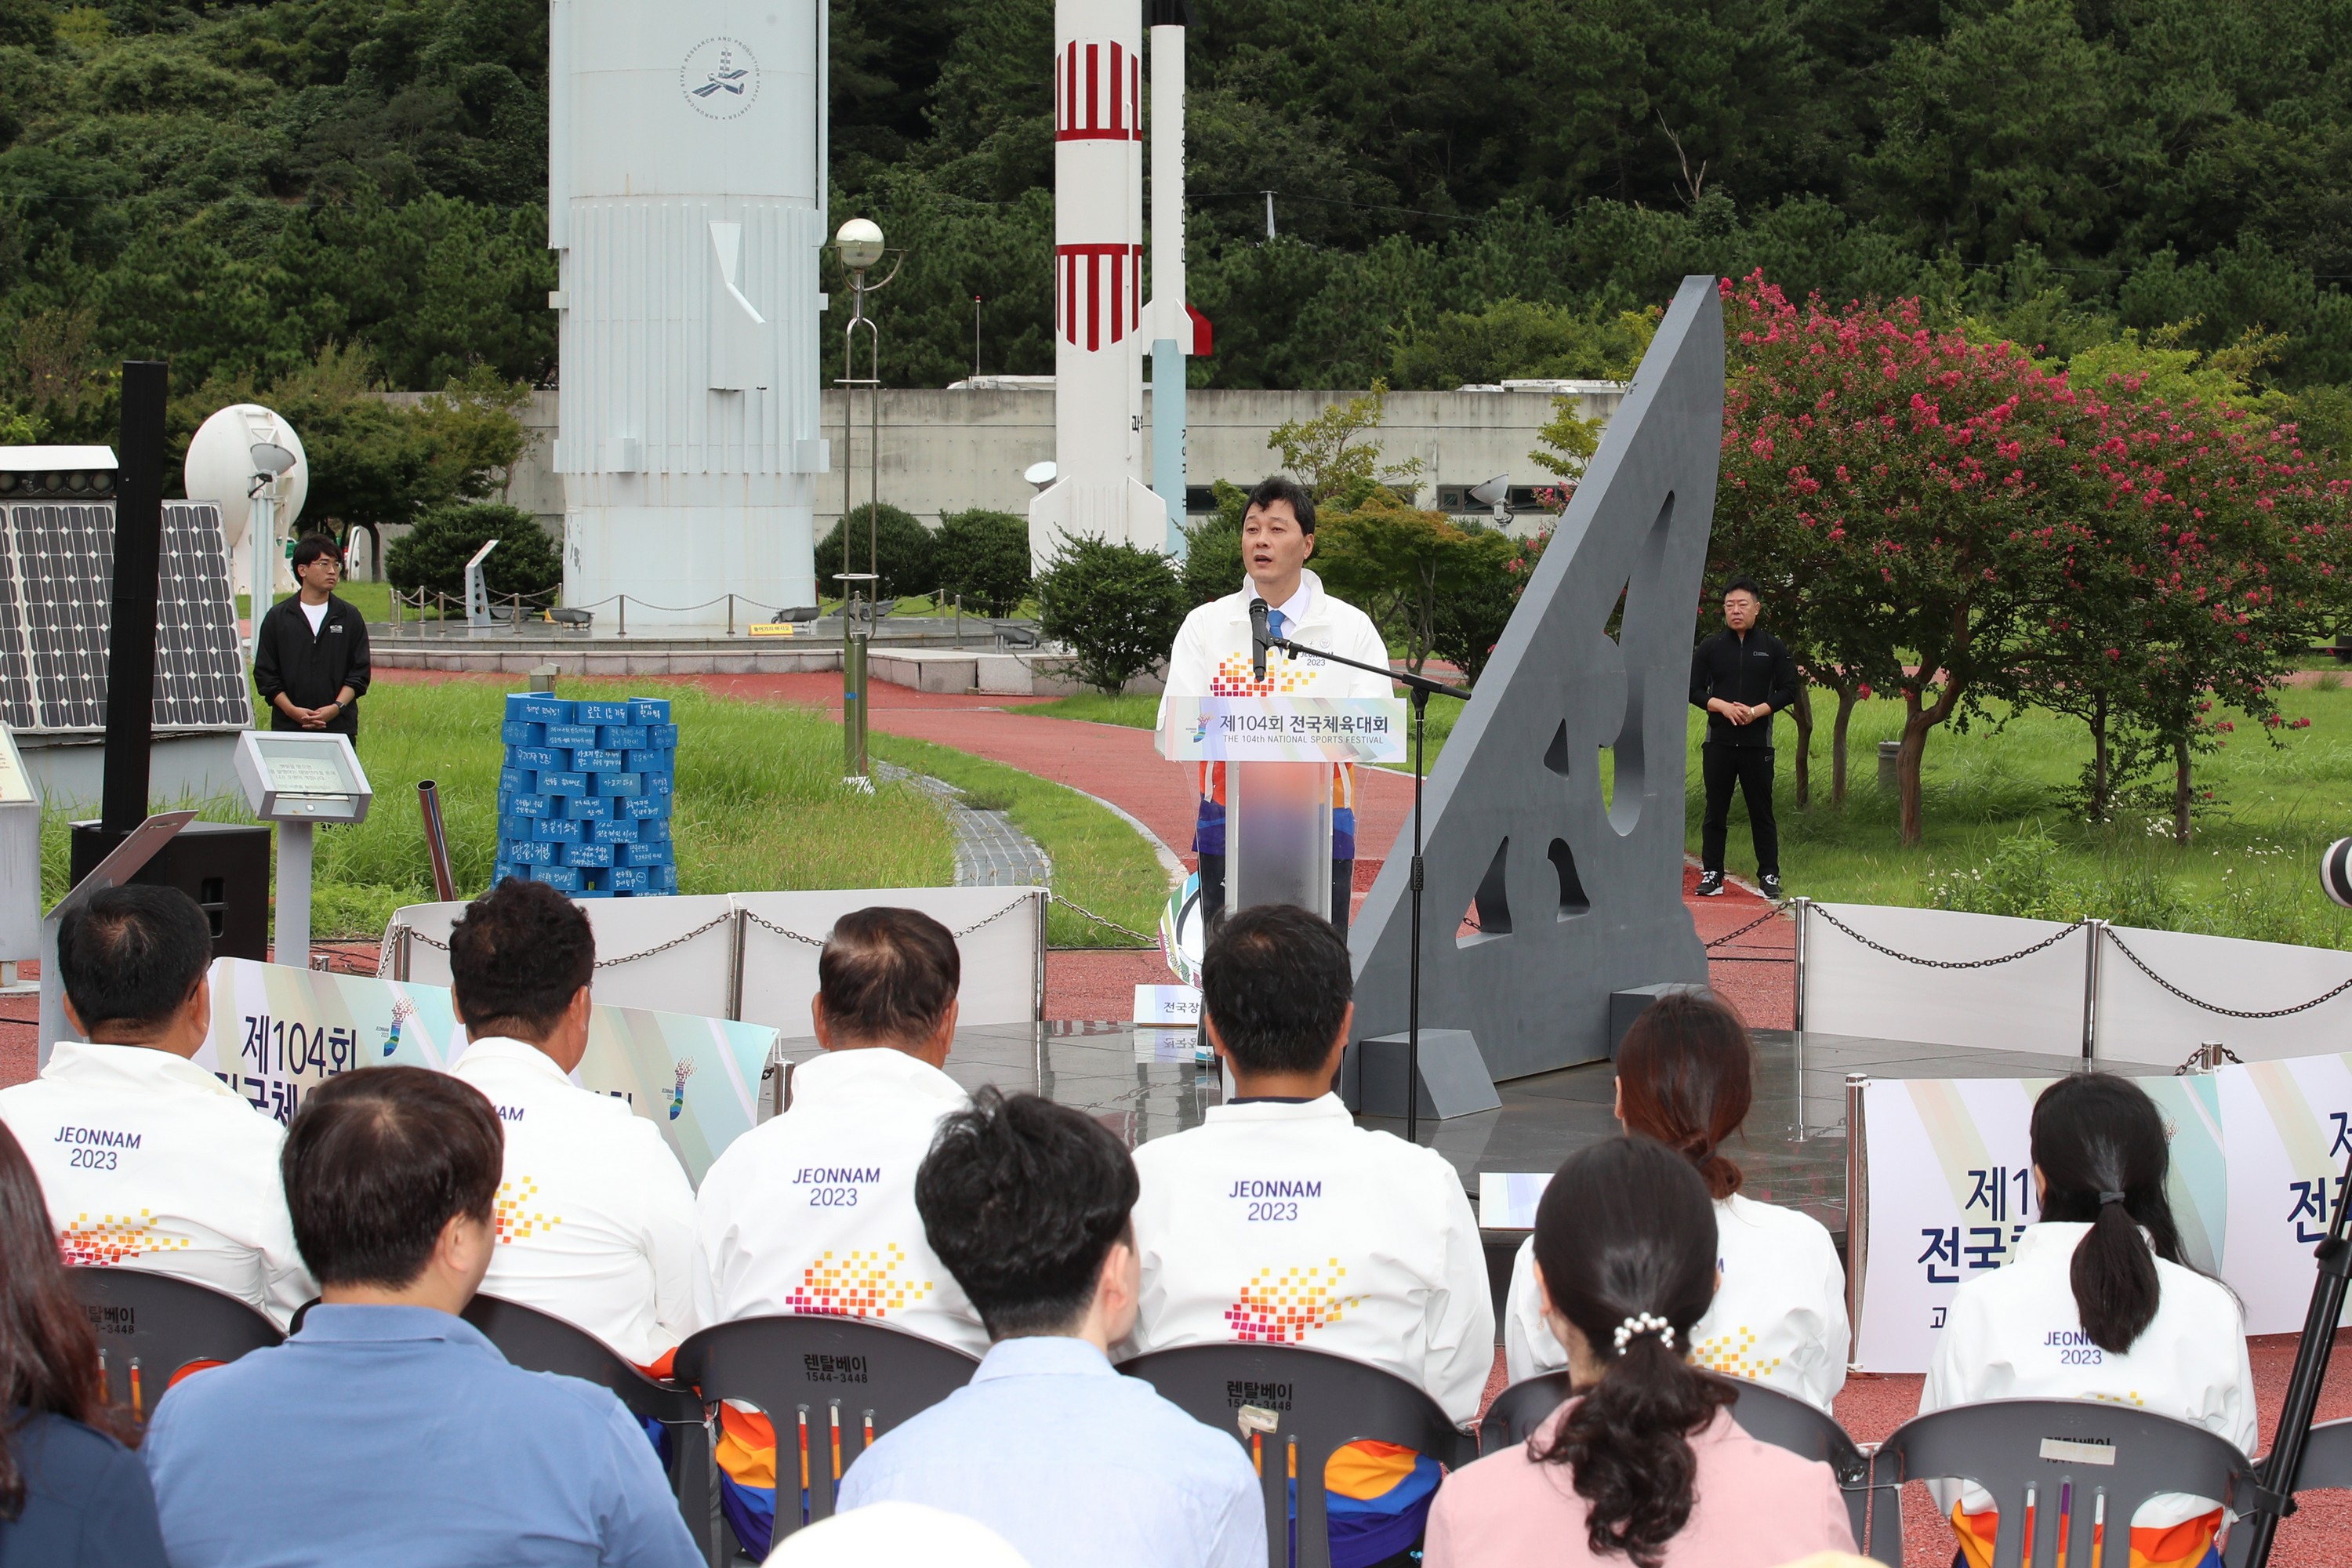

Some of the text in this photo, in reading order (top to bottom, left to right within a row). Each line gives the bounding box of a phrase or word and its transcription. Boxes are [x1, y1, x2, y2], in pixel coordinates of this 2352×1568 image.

[684, 38, 714, 63] RESEARCH
[734, 39, 760, 77] PRODUCTION
[750, 80, 760, 103] SPACE
[728, 103, 752, 120] CENTER
[587, 706, 602, 719] 로또
[1219, 714, 1388, 734] 제104회 전국체육대회
[1242, 735, 1265, 743] 104th
[1267, 735, 1308, 743] NATIONAL
[1310, 735, 1344, 744] SPORTS
[1345, 735, 1384, 744] FESTIVAL
[1167, 951, 1191, 979] JEONNAM
[1163, 1002, 1200, 1014] 전국장
[241, 1014, 357, 1079] 제104회
[54, 1126, 142, 1149] JEONNAM
[70, 1148, 118, 1171] 2023
[792, 1167, 880, 1184] JEONNAM
[810, 1188, 858, 1207] 2023
[1229, 1180, 1322, 1198] JEONNAM
[1965, 1166, 2029, 1222] 제1
[1247, 1202, 1298, 1221] 2023
[1918, 1225, 2027, 1283] 전국
[81, 1305, 135, 1324] 탈베이
[2043, 1331, 2097, 1346] JEON
[804, 1354, 867, 1373] 렌탈베이
[2060, 1349, 2103, 1365] 2023
[806, 1371, 868, 1384] 1544-3448
[1227, 1381, 1292, 1401] 렌탈베이
